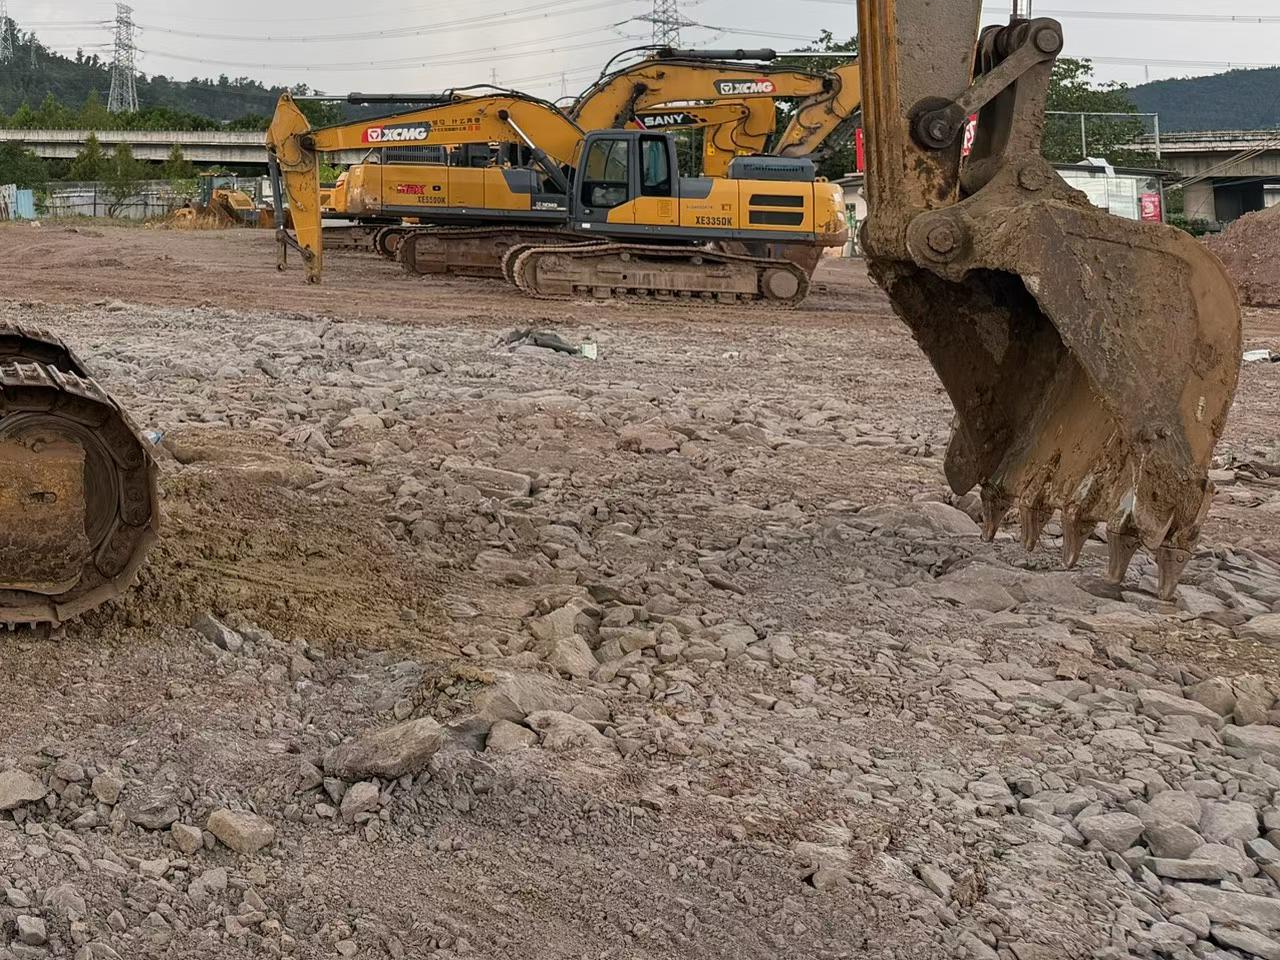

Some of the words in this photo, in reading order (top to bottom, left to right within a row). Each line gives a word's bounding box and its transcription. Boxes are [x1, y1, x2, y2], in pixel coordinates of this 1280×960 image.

[734, 81, 773, 95] XCMG
[644, 113, 685, 127] SANY
[381, 127, 428, 142] XCMG
